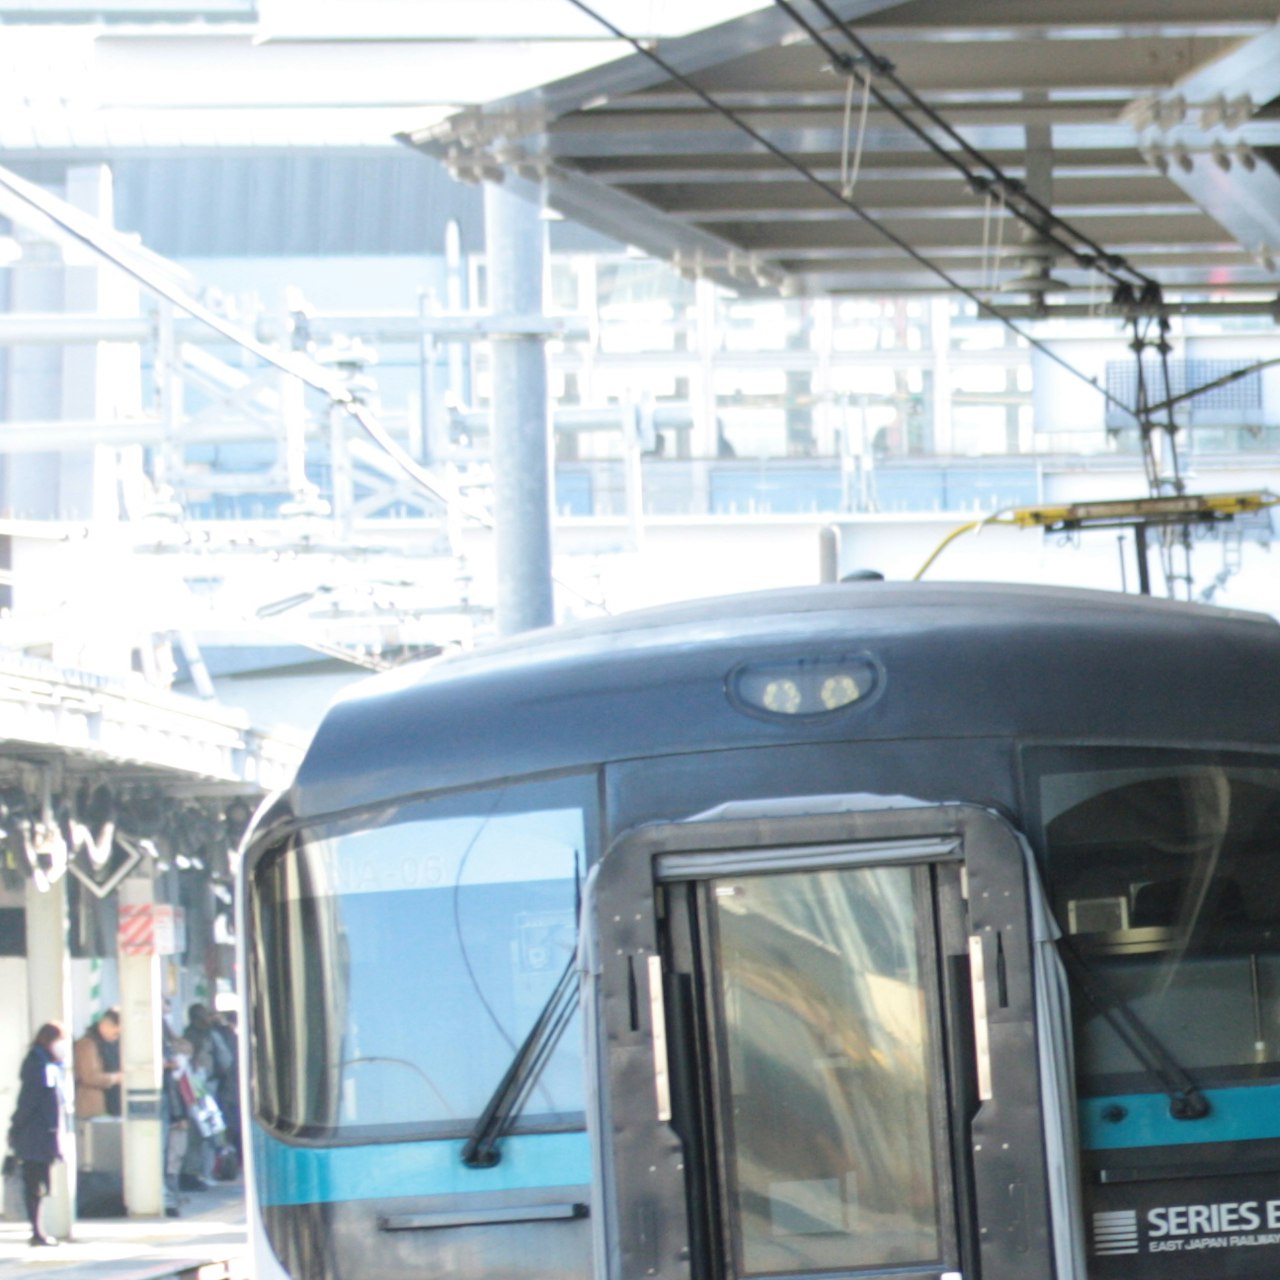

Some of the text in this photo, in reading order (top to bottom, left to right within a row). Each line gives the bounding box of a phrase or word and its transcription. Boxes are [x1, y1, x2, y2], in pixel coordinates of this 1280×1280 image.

[1146, 1201, 1261, 1237] SERIES
[1148, 1239, 1184, 1253] EAST
[1185, 1237, 1228, 1250] JAPAN
